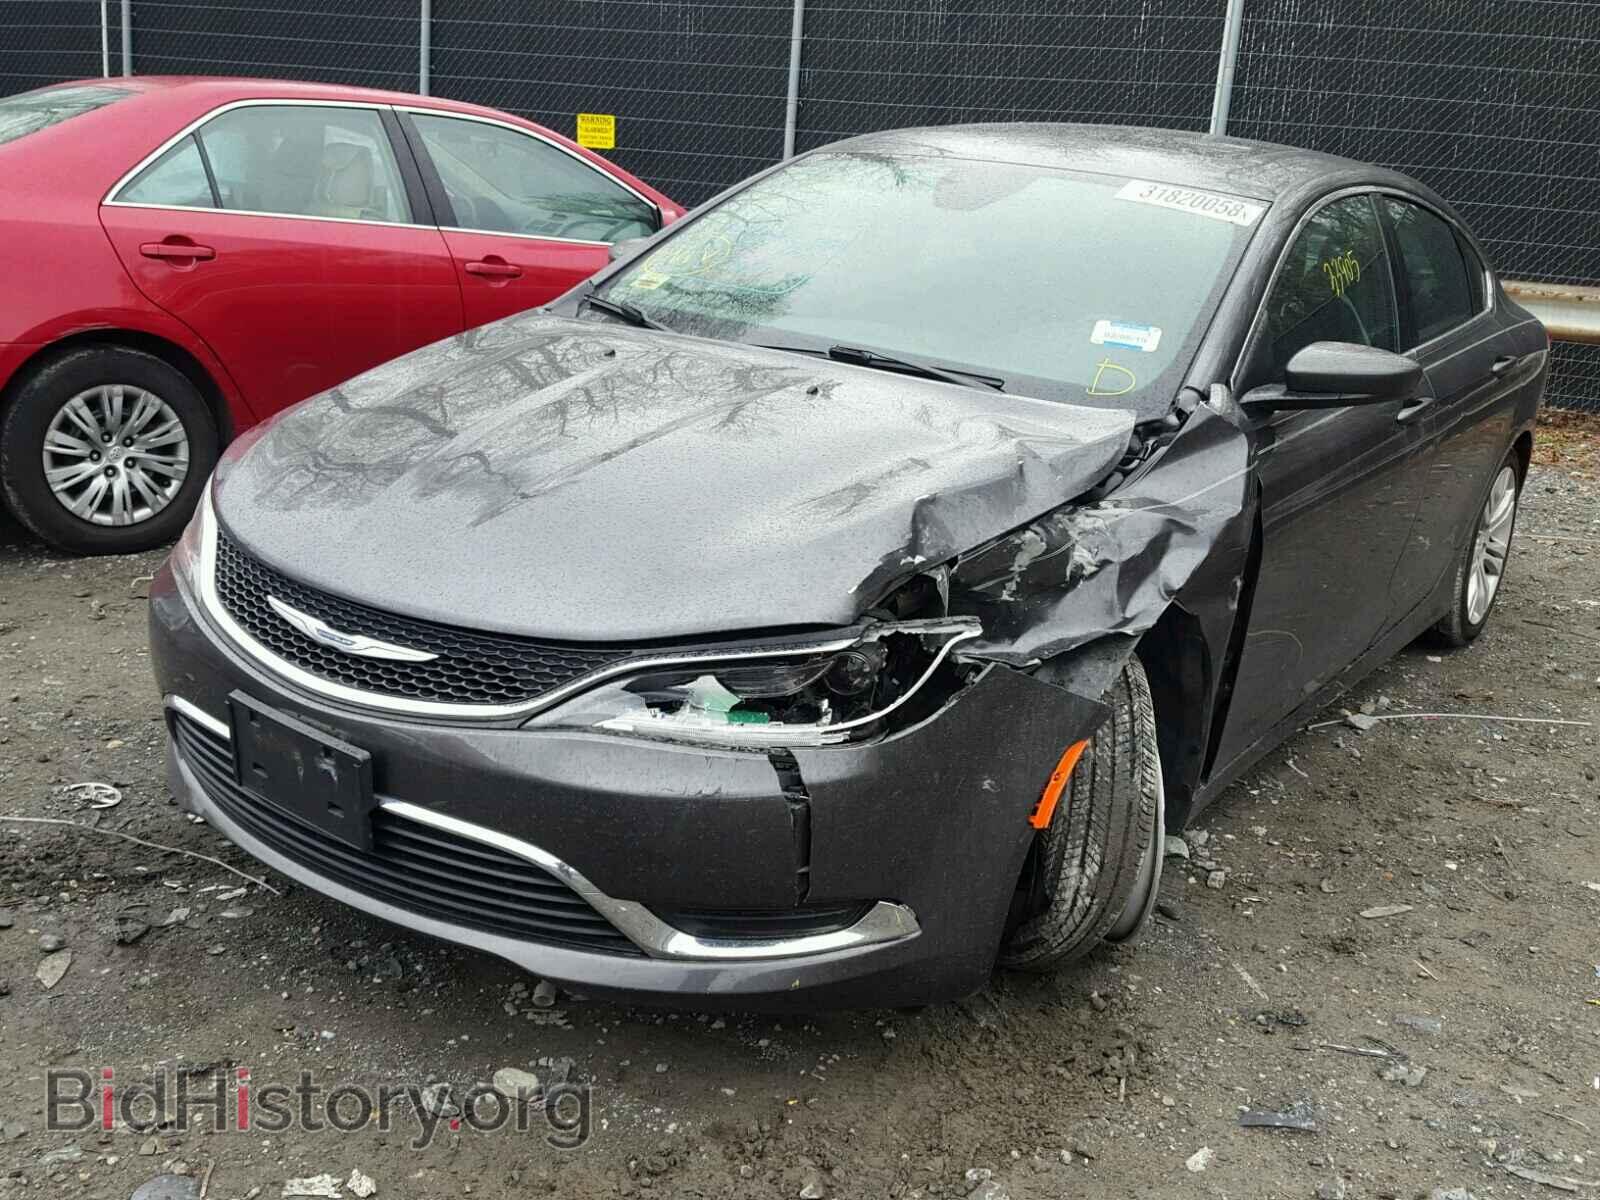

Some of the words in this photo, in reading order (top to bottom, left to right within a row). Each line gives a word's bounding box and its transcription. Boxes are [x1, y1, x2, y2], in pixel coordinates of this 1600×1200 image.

[580, 116, 612, 125] WARNING
[1139, 184, 1242, 217] 31820058
[1087, 358, 1136, 396] D
